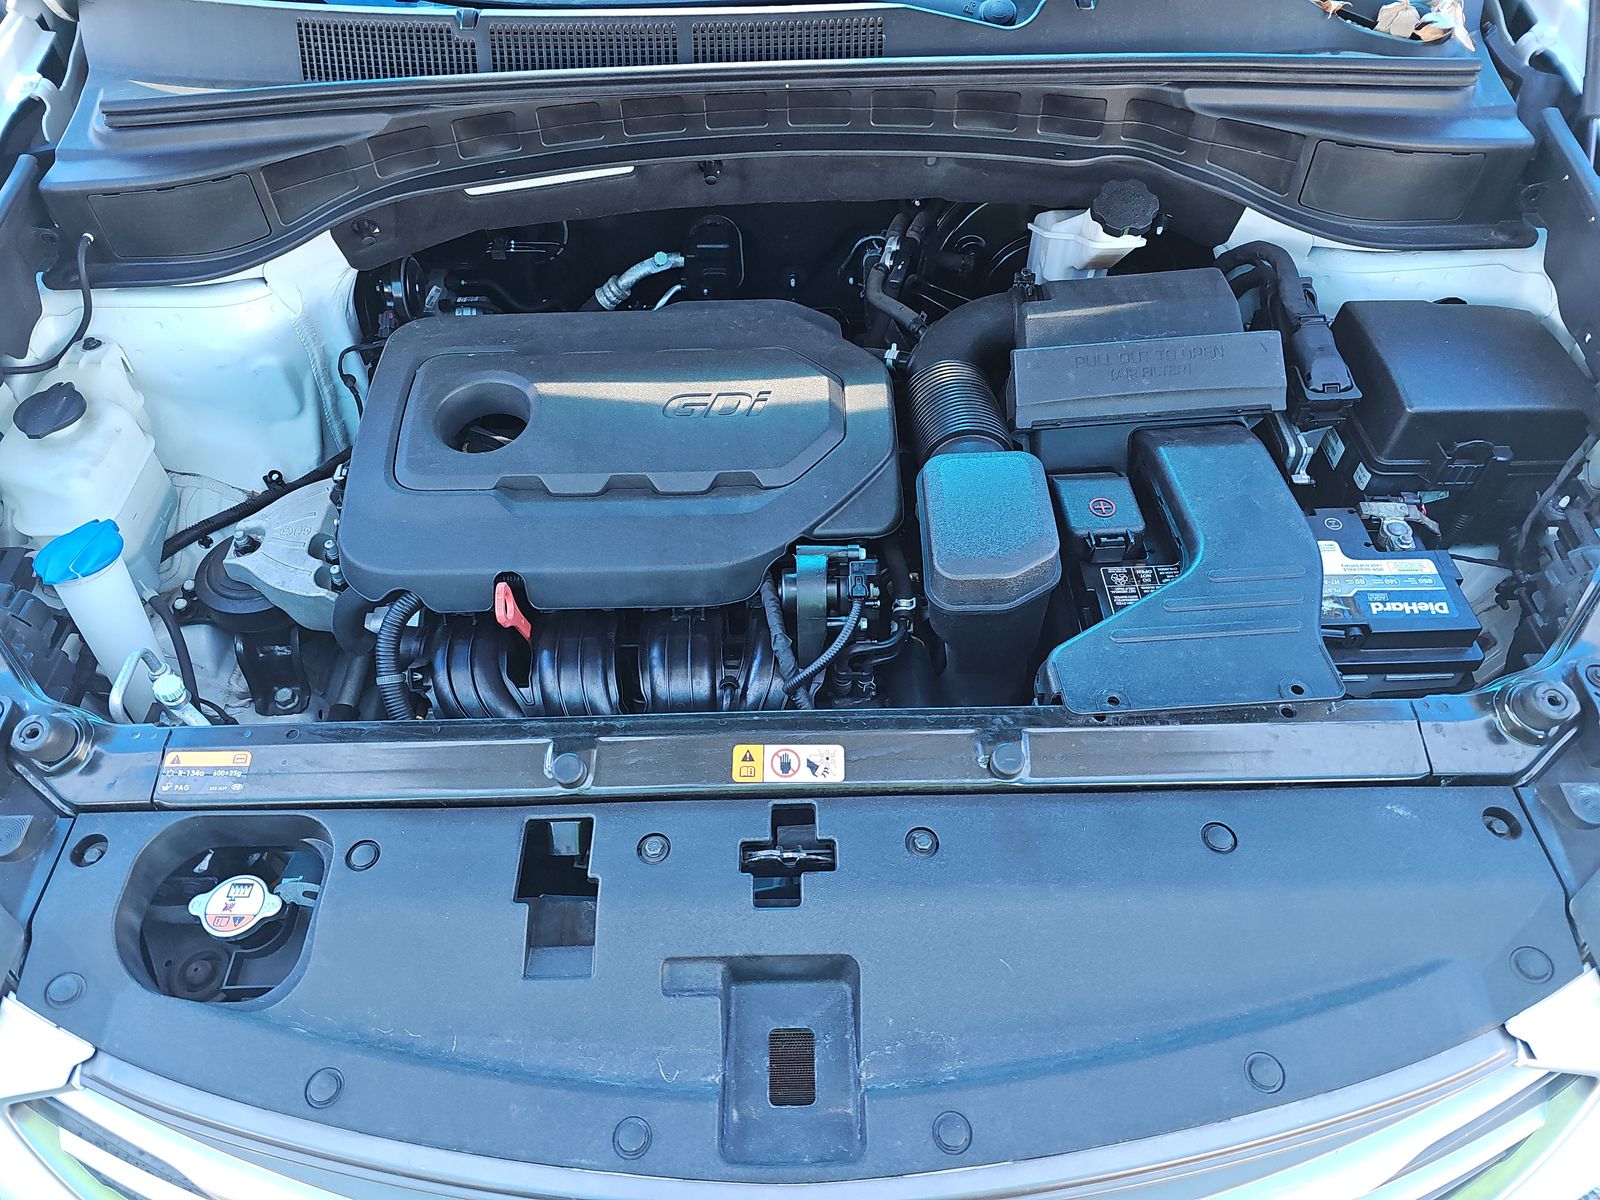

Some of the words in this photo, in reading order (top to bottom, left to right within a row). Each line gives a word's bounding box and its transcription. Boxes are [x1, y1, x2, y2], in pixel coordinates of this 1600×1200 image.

[1075, 355, 1110, 368] PULL
[1119, 351, 1149, 365] OUT
[1155, 348, 1177, 362] TO
[1181, 345, 1224, 360] OPEN
[1370, 601, 1450, 615] DieHard
[177, 769, 205, 777] R-134a
